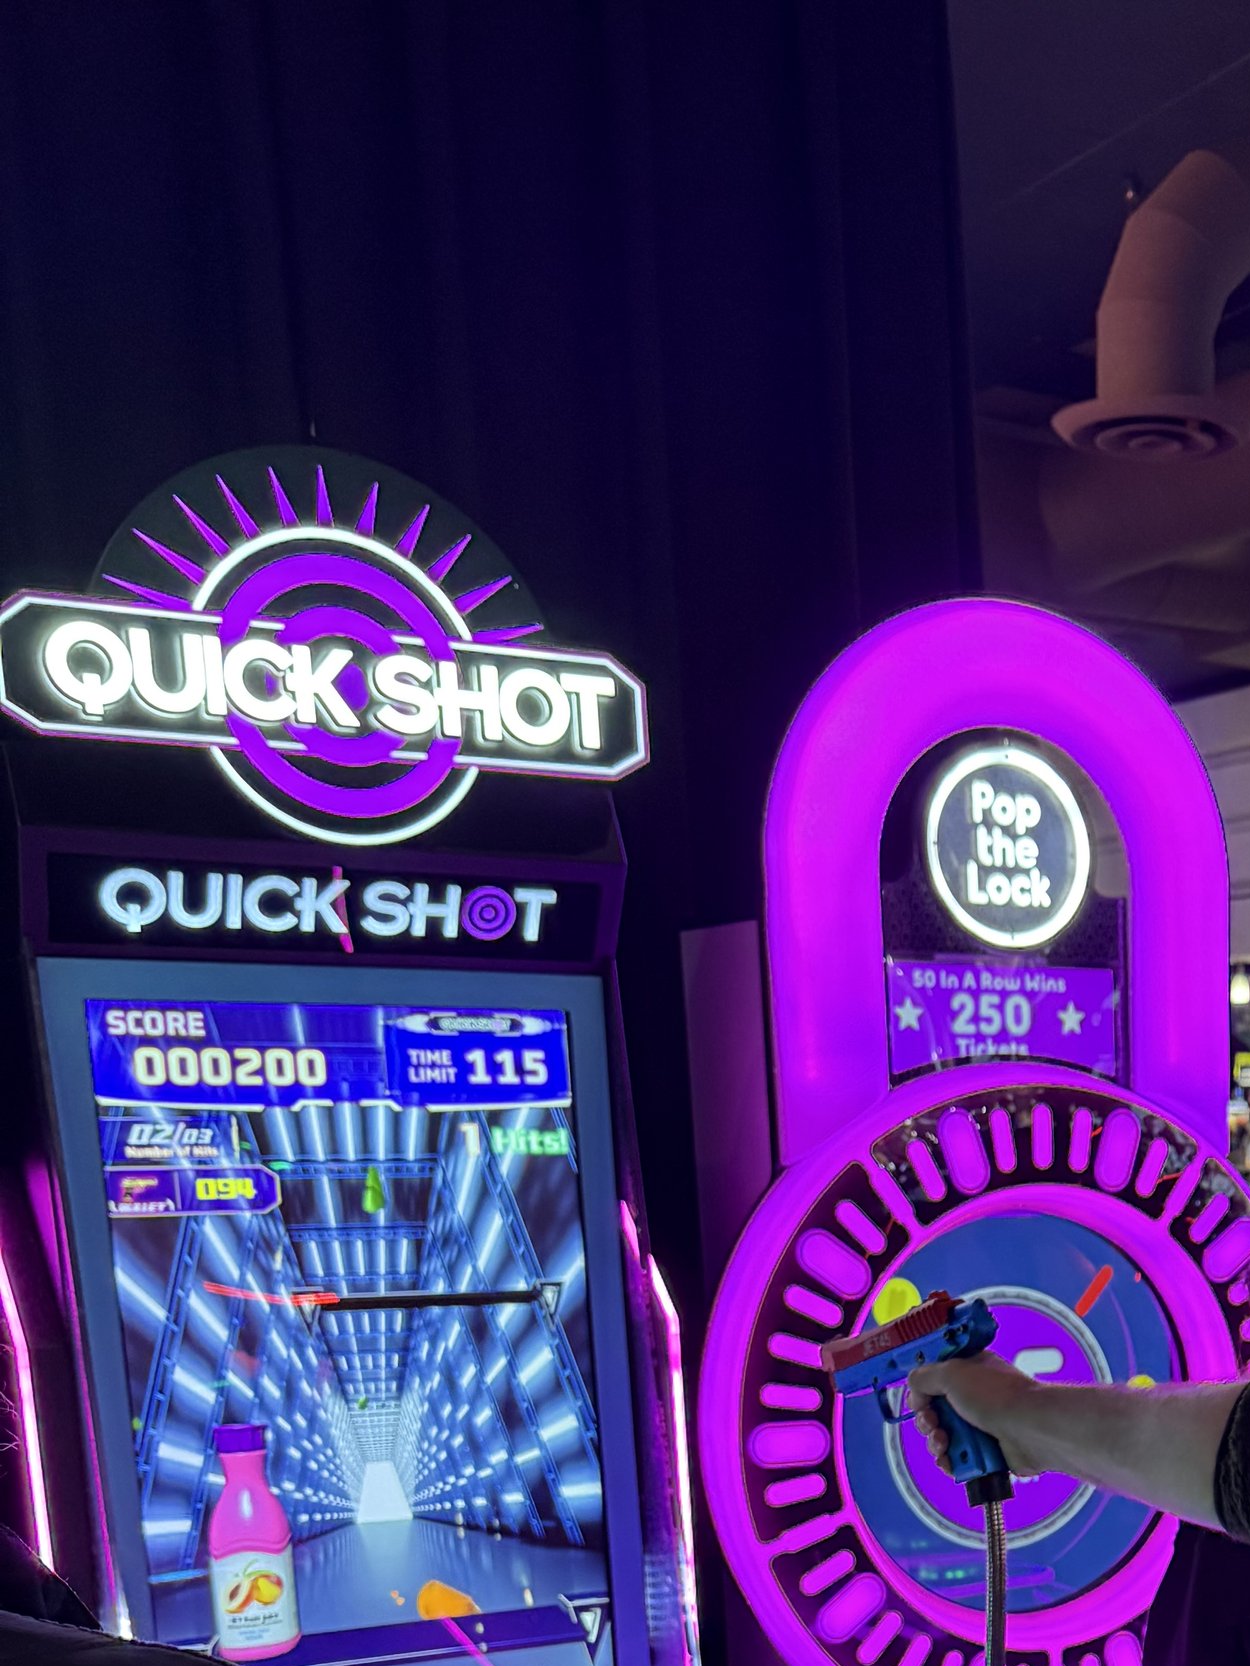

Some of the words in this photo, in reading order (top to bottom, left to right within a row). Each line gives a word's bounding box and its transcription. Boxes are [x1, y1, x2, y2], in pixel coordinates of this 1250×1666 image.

[44, 620, 363, 728] QUICK
[370, 656, 615, 749] SHOT
[970, 778, 1042, 835] Pop
[976, 823, 1040, 869] the
[966, 858, 1052, 908] Lock
[98, 866, 350, 936] QUICK
[360, 878, 559, 943] SHOT
[911, 968, 937, 989] 50
[939, 969, 960, 990] In
[962, 969, 977, 991] A
[979, 969, 1021, 992] Row
[1024, 972, 1067, 994] Wins
[105, 1009, 206, 1038] SCORE
[950, 991, 1032, 1037] 250
[407, 1048, 453, 1066] TIME
[955, 1036, 1030, 1058] Tickets
[133, 1046, 327, 1087] 000200
[408, 1066, 458, 1084] LIMIT
[464, 1048, 550, 1085] 115
[490, 1125, 570, 1156] Hits!
[194, 1177, 257, 1201] 094
